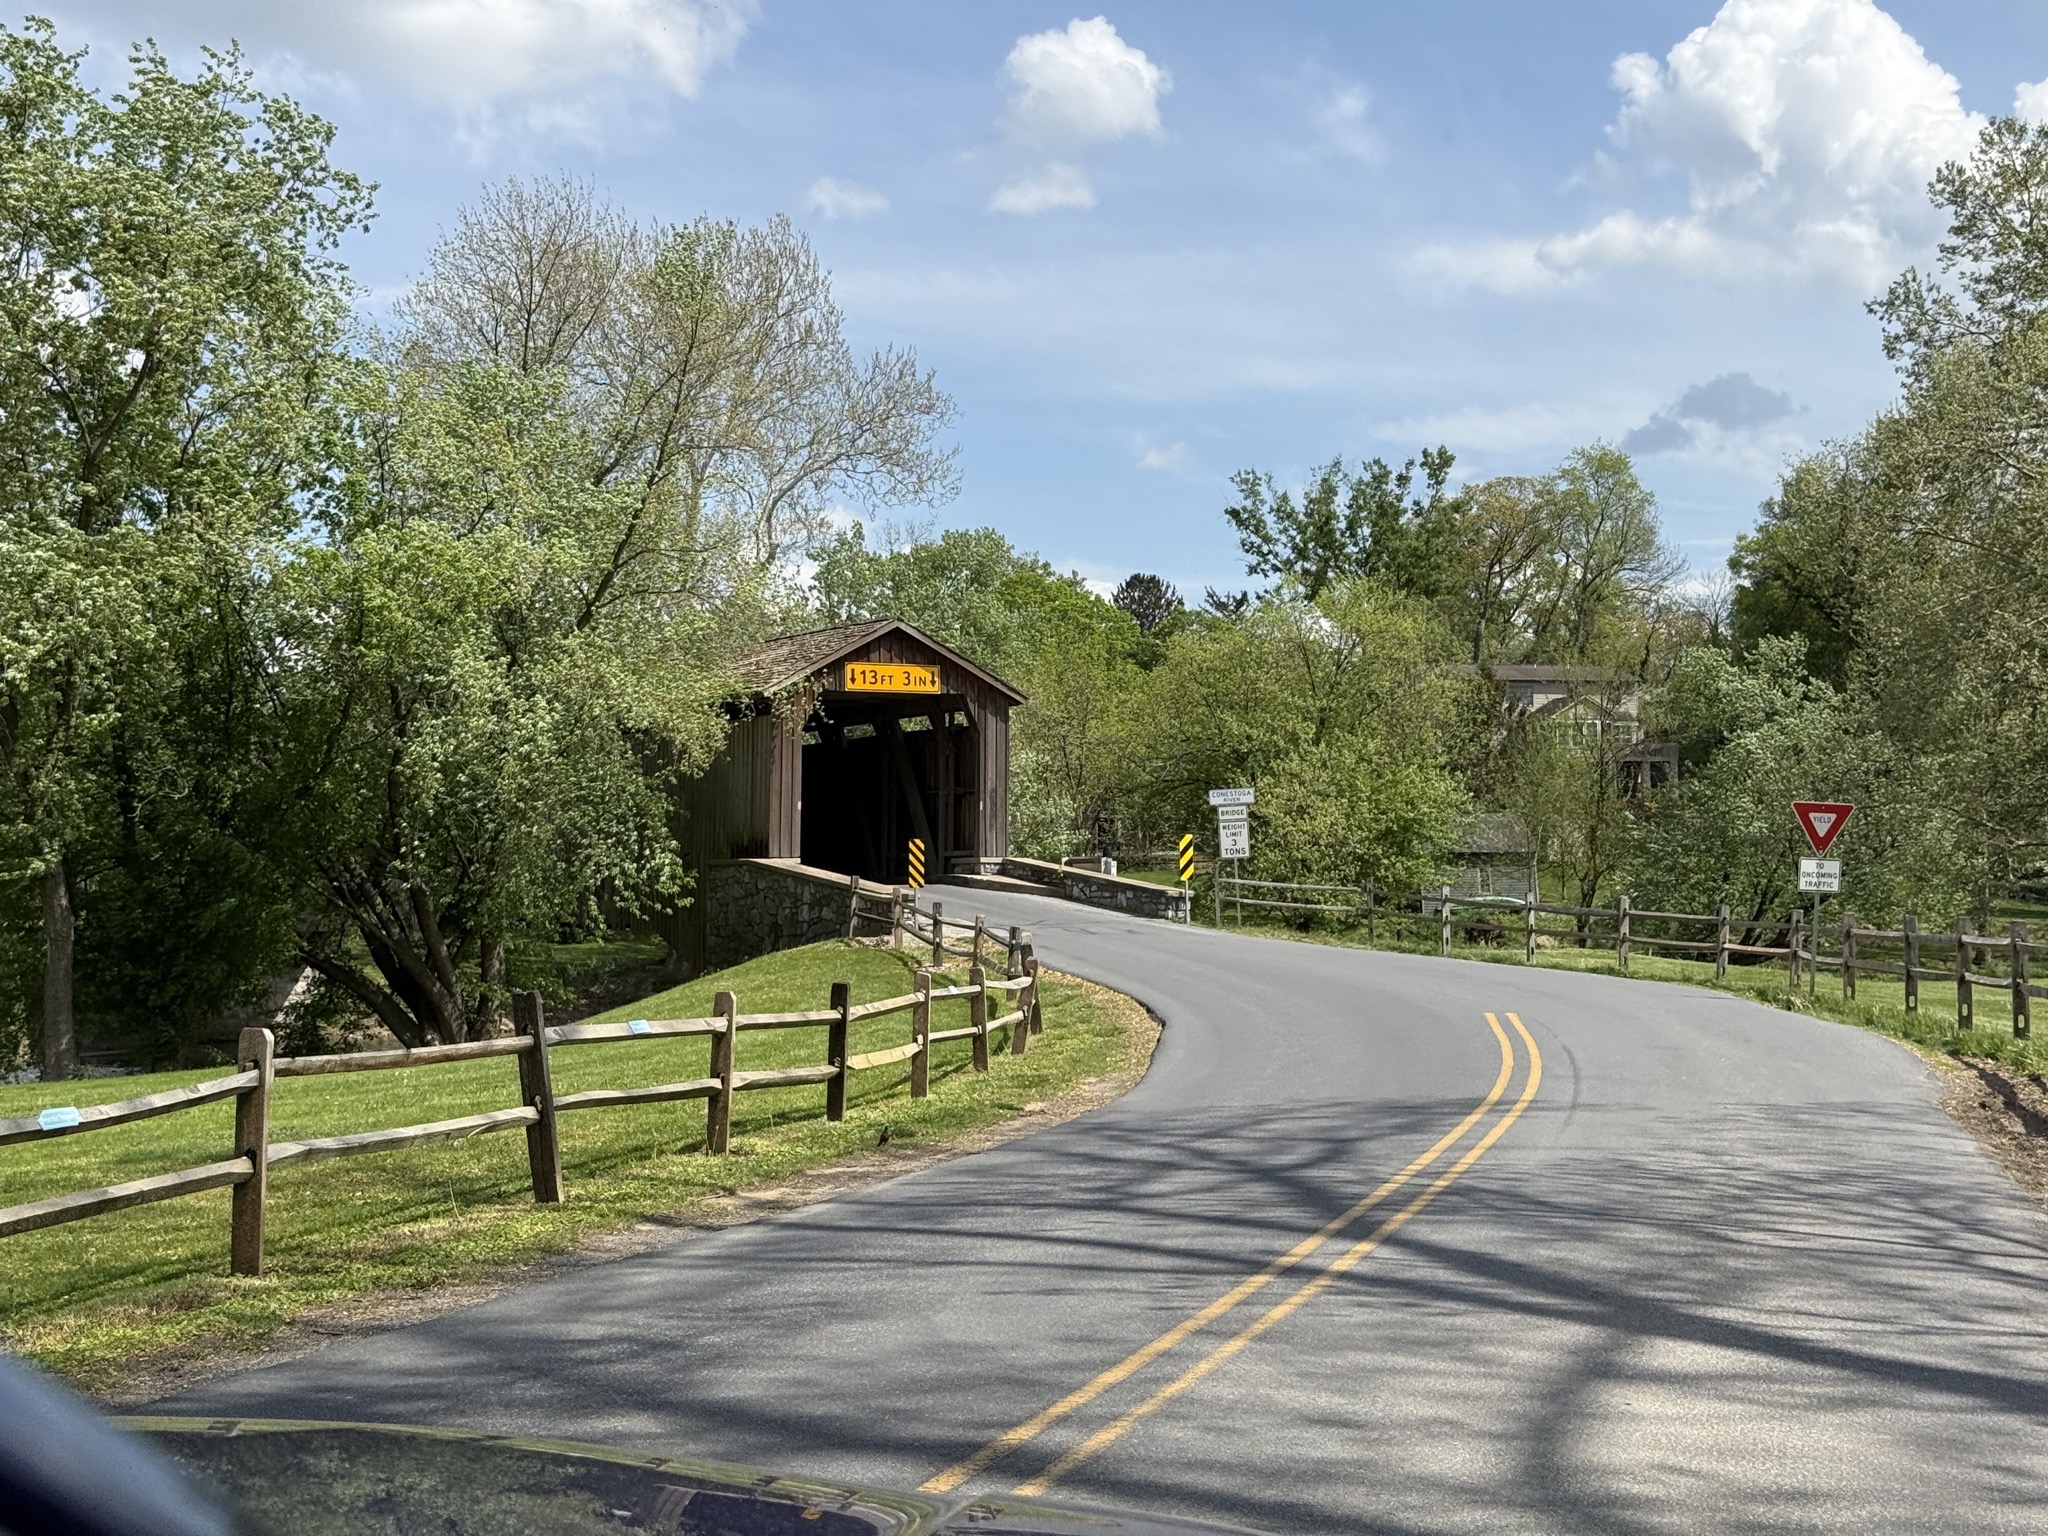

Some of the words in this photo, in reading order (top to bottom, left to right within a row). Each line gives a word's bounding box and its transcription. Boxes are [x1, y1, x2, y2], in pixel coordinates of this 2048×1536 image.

[902, 671, 911, 686] 3
[914, 676, 927, 687] IN
[1211, 790, 1252, 798] CONESTOGA
[1220, 809, 1245, 817] BRIDGE
[1224, 848, 1246, 856] TONS
[1801, 871, 1838, 879] ONCOMING
[1804, 881, 1834, 889] TRAFFIC
